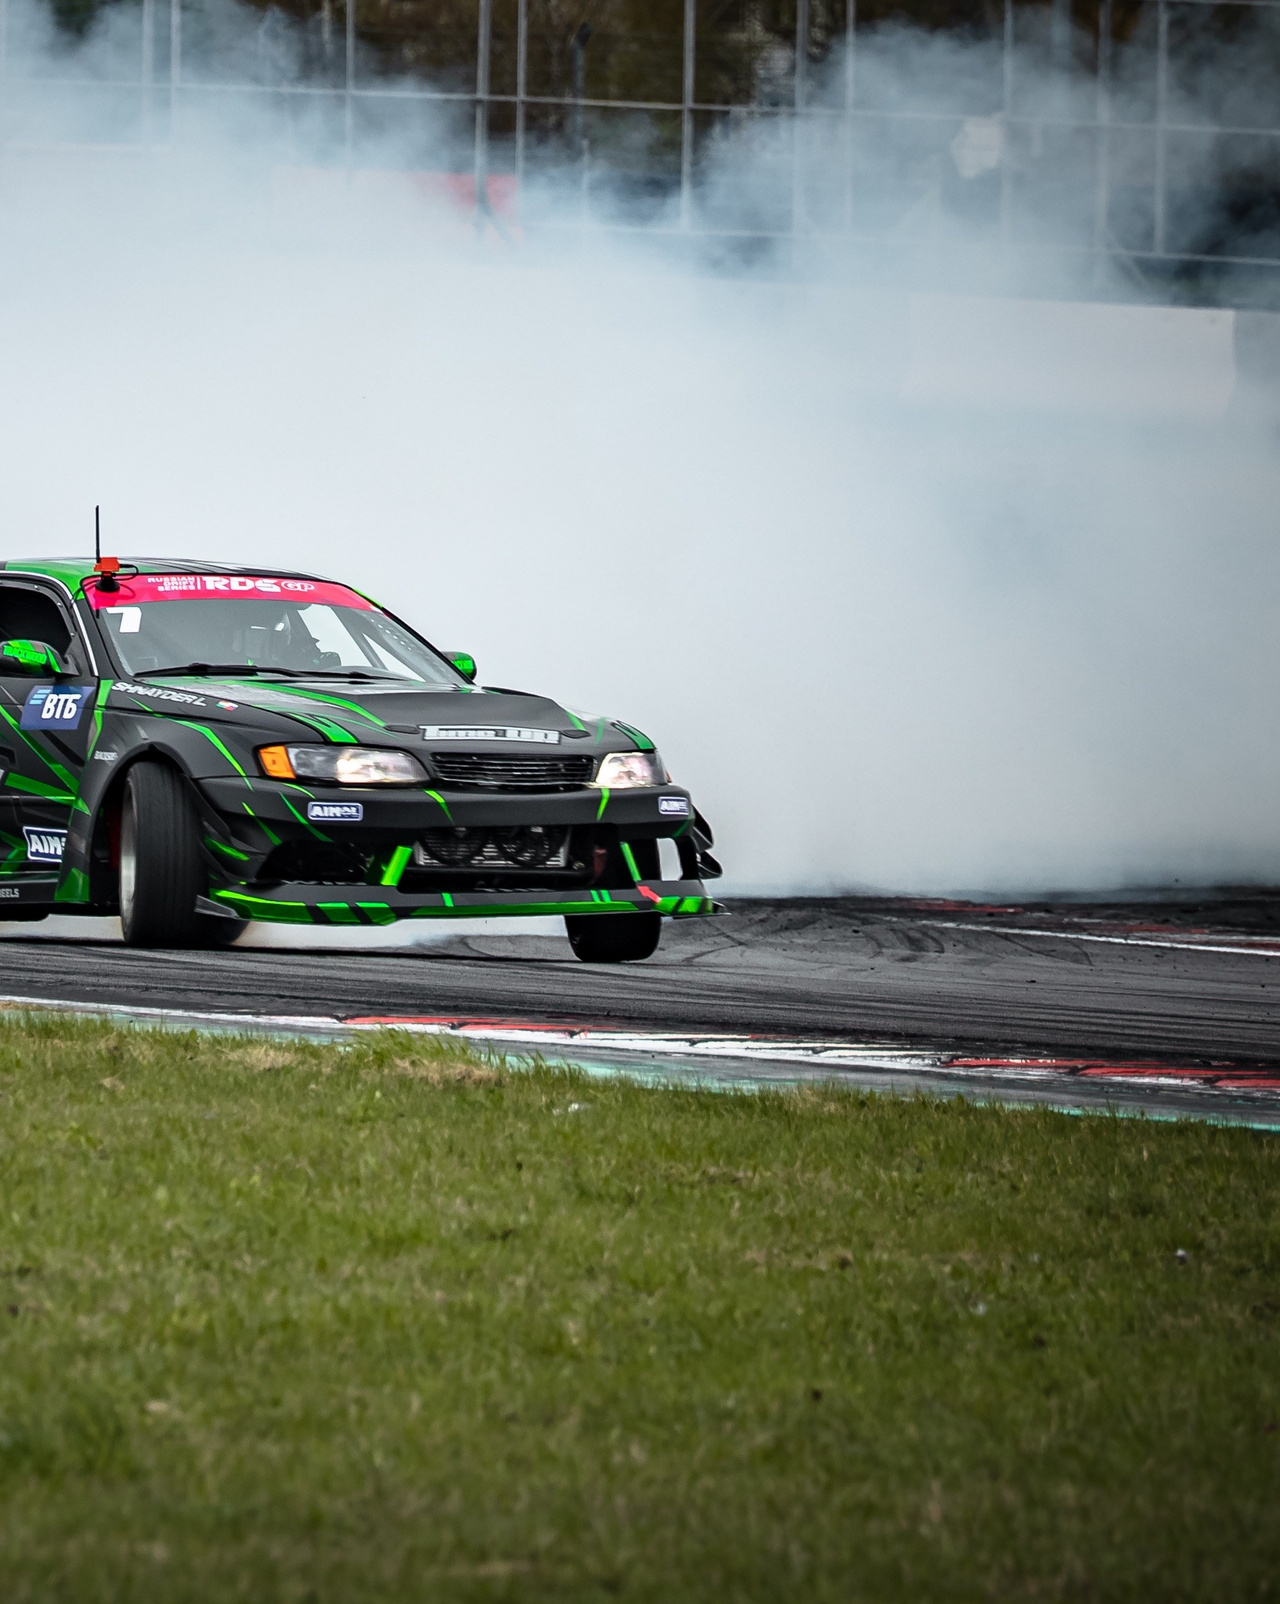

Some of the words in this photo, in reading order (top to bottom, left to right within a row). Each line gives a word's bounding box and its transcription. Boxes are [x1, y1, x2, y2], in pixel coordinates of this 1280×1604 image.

[202, 576, 281, 593] RDS
[106, 606, 142, 633] 7
[41, 693, 83, 720] ВТБ
